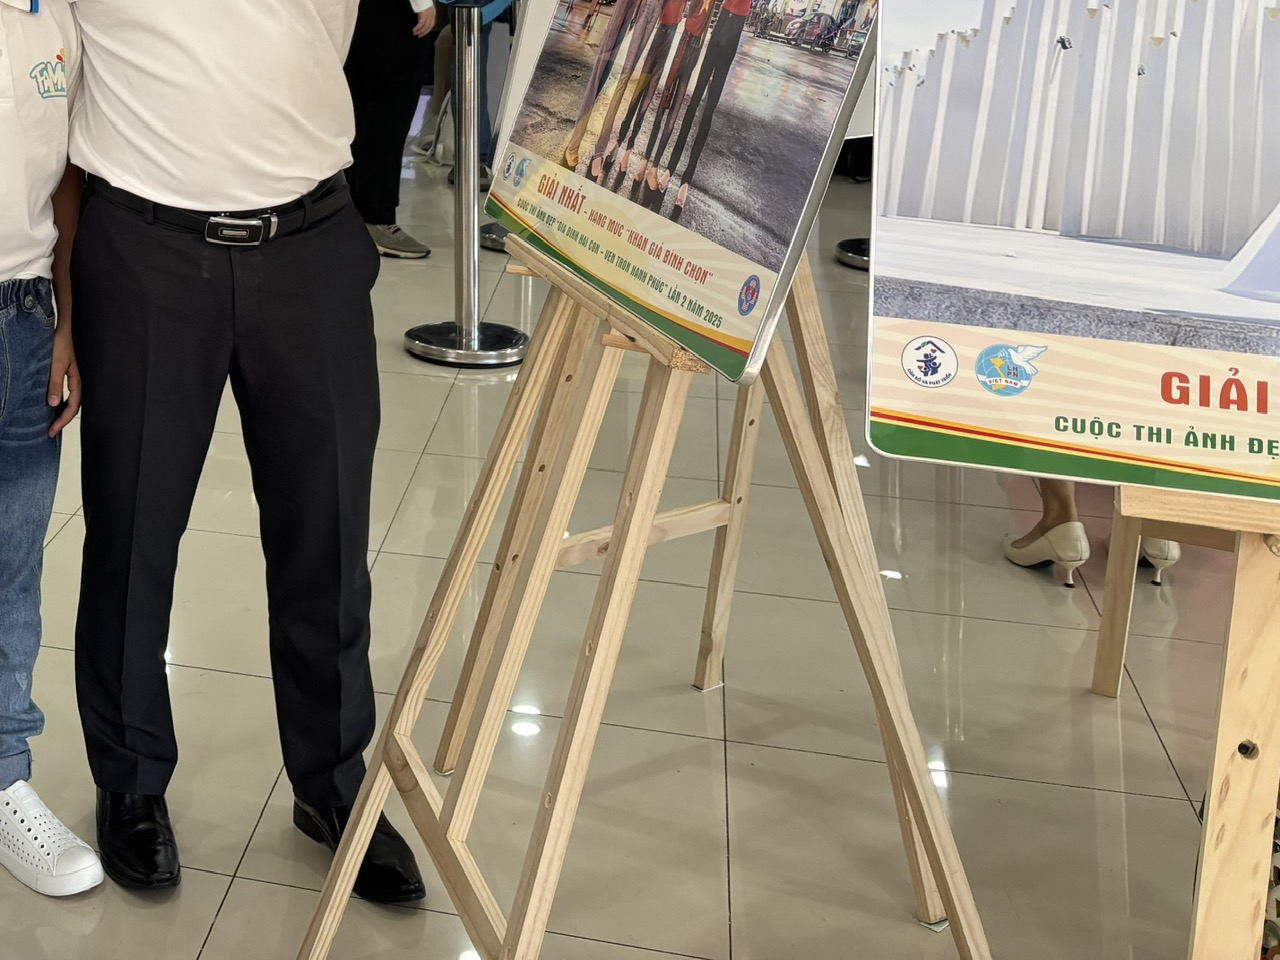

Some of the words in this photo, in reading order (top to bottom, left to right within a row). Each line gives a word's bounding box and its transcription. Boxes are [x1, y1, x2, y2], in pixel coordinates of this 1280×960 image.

[537, 173, 560, 200] GIẢI
[558, 185, 587, 214] NHẤT
[588, 209, 607, 227] HẠNG
[648, 242, 664, 260] GIẢ
[578, 233, 589, 248] HAI
[588, 240, 600, 254] CON
[630, 265, 648, 283] HẠNH
[680, 295, 687, 308] 2
[686, 299, 704, 318] NĂM
[703, 309, 723, 328] 2025
[1160, 366, 1268, 414] GIẢI
[1054, 416, 1122, 440] CUỘC
[1133, 424, 1172, 444] THI
[1184, 426, 1236, 452] ẢNH
